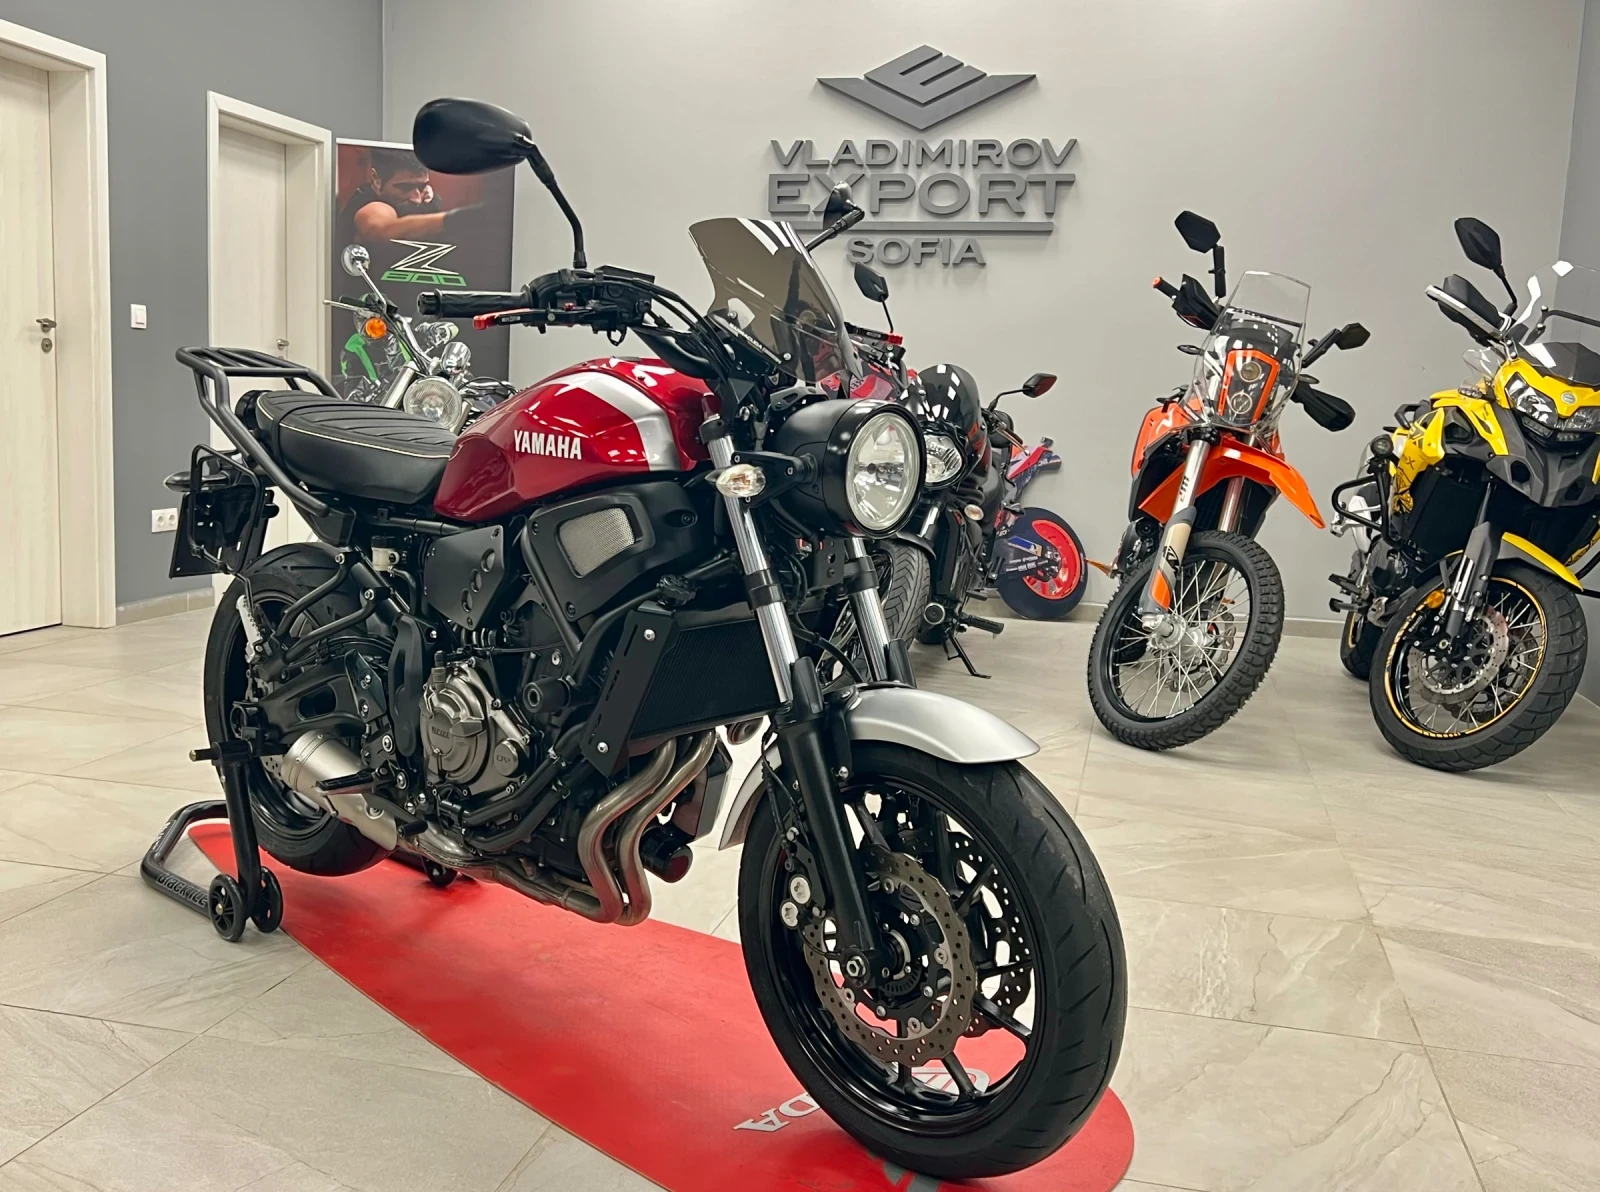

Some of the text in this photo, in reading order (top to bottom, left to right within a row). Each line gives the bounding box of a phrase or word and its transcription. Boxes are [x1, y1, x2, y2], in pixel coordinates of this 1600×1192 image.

[770, 138, 1078, 167] VLADIMIROV
[846, 237, 987, 267] SOFIA
[381, 270, 467, 287] 800
[513, 429, 582, 460] YAMAHA
